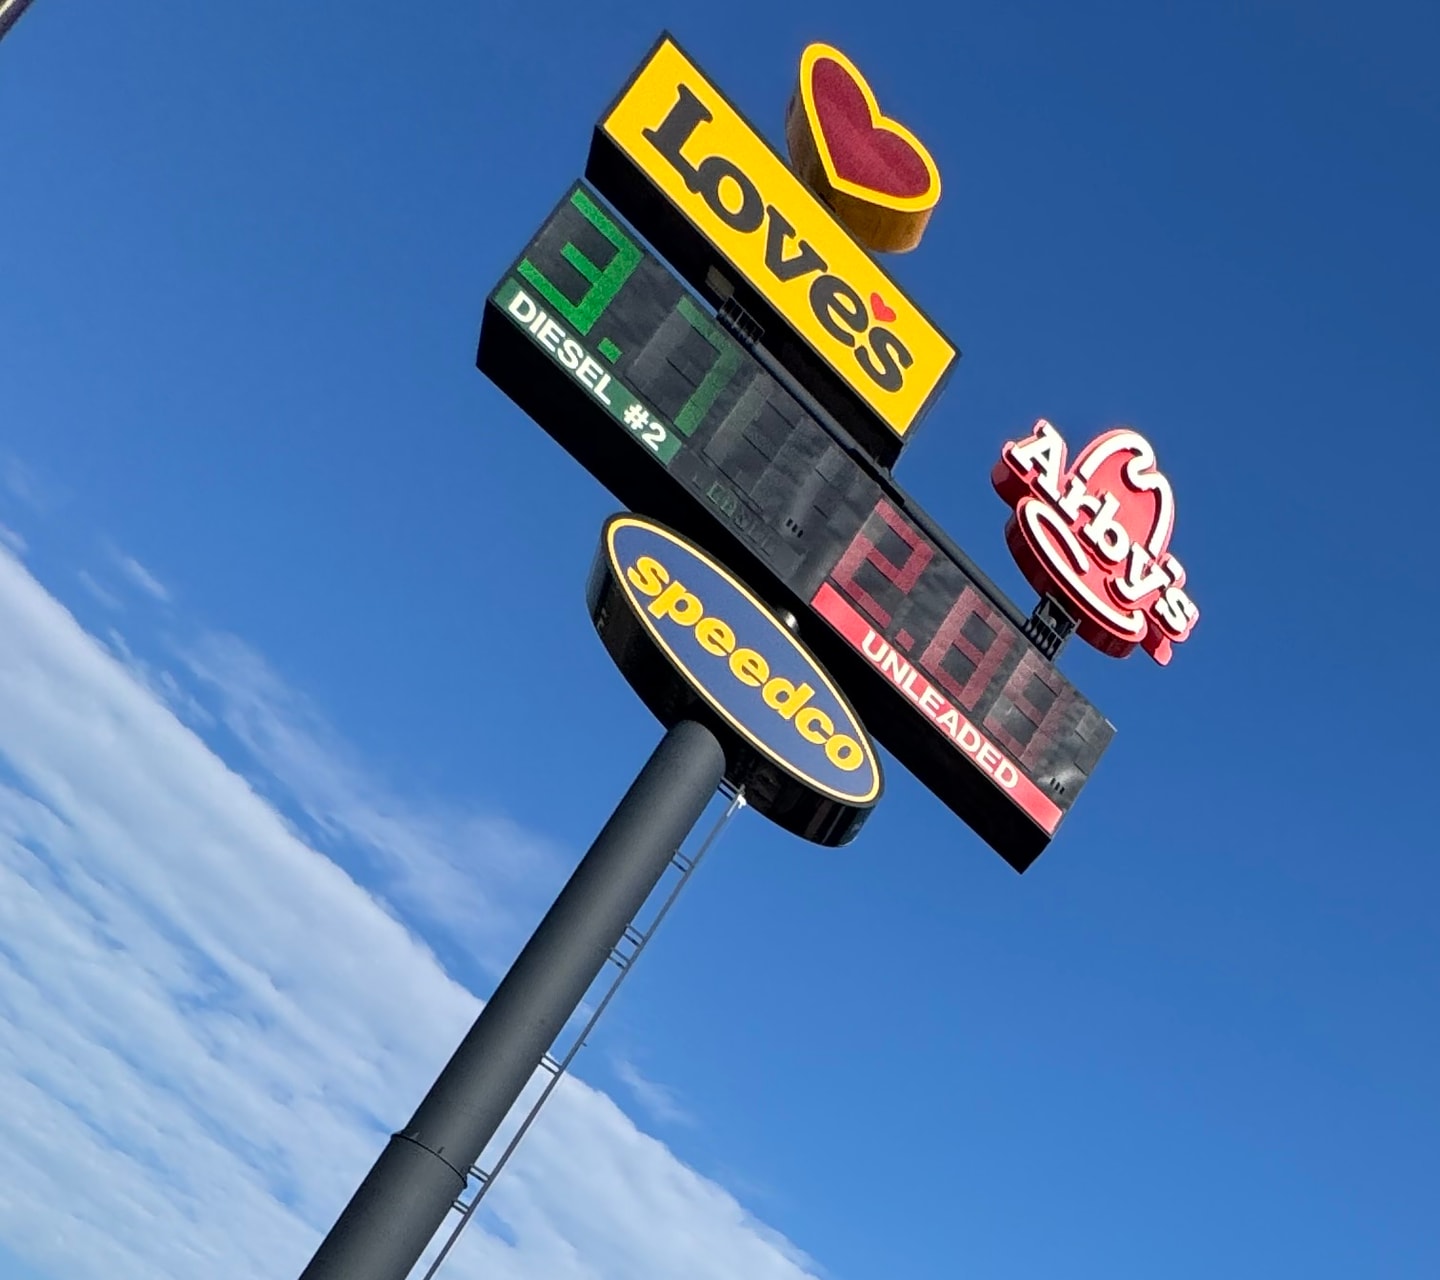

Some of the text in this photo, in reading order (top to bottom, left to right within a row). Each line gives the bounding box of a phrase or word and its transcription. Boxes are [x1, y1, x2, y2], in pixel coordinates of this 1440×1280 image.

[508, 292, 668, 451] DIESEL #2
[1006, 420, 1196, 634] Arby's
[628, 556, 864, 771] speedco
[861, 632, 1019, 789] UNLEADED
